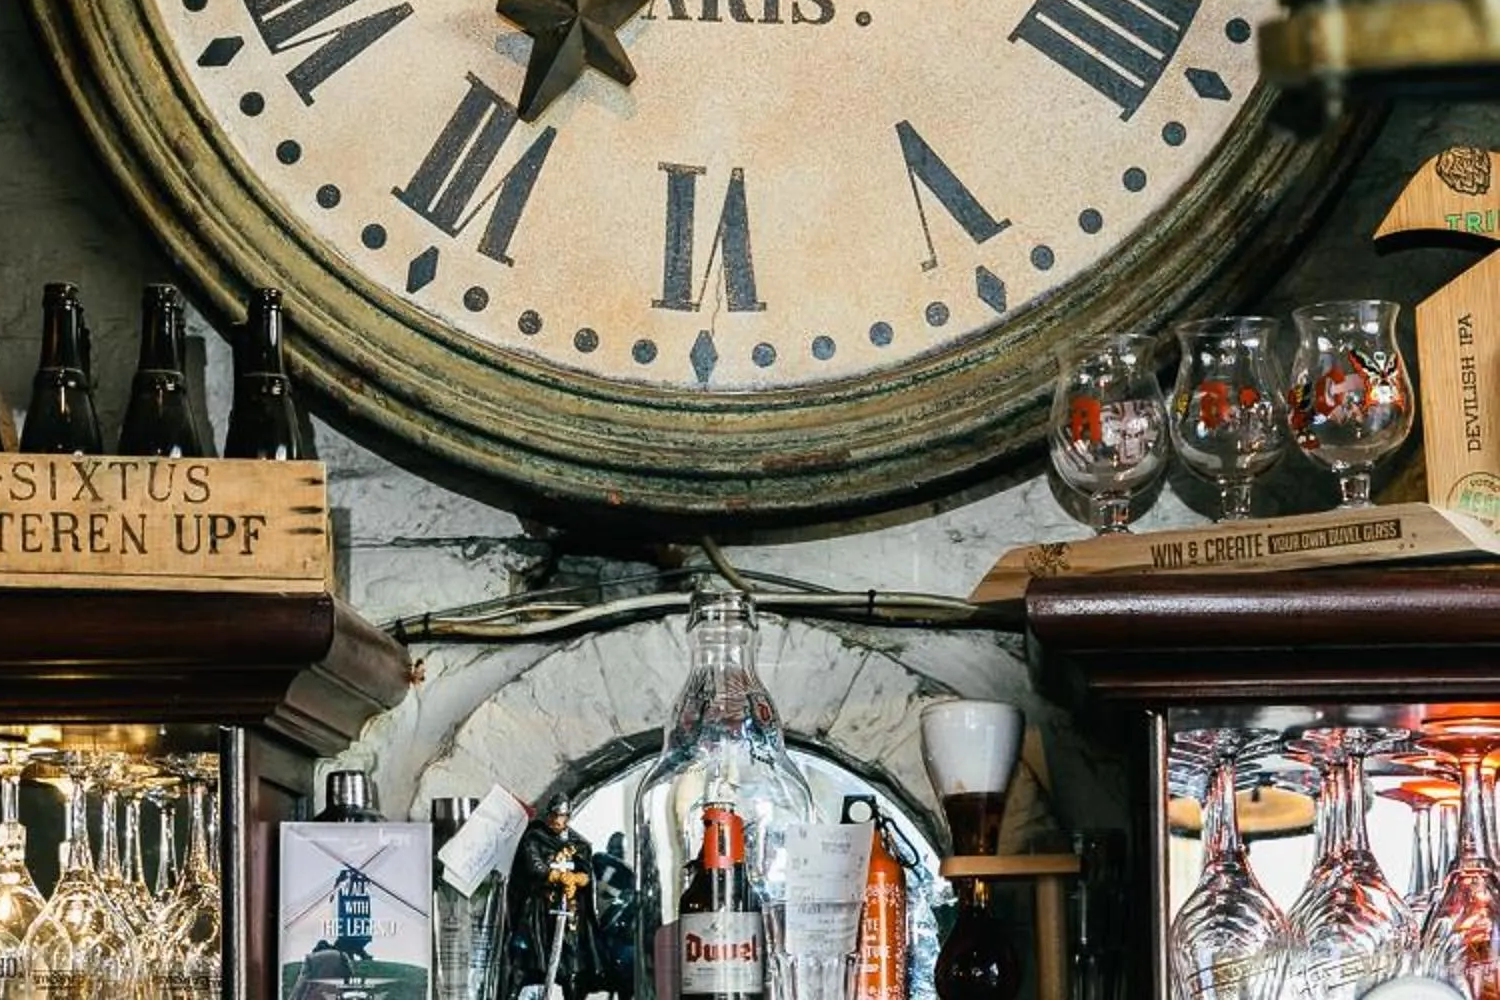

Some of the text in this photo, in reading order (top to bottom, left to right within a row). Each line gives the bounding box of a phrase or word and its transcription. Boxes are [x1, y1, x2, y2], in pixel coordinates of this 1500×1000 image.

[1460, 312, 1481, 454] DEVILISH IPA
[173, 513, 267, 556] UPF
[1151, 542, 1183, 568] WIN
[1188, 541, 1198, 564] &
[1204, 534, 1263, 562] CREATE
[1271, 536, 1300, 554] YOUR
[1301, 531, 1327, 549] OWN
